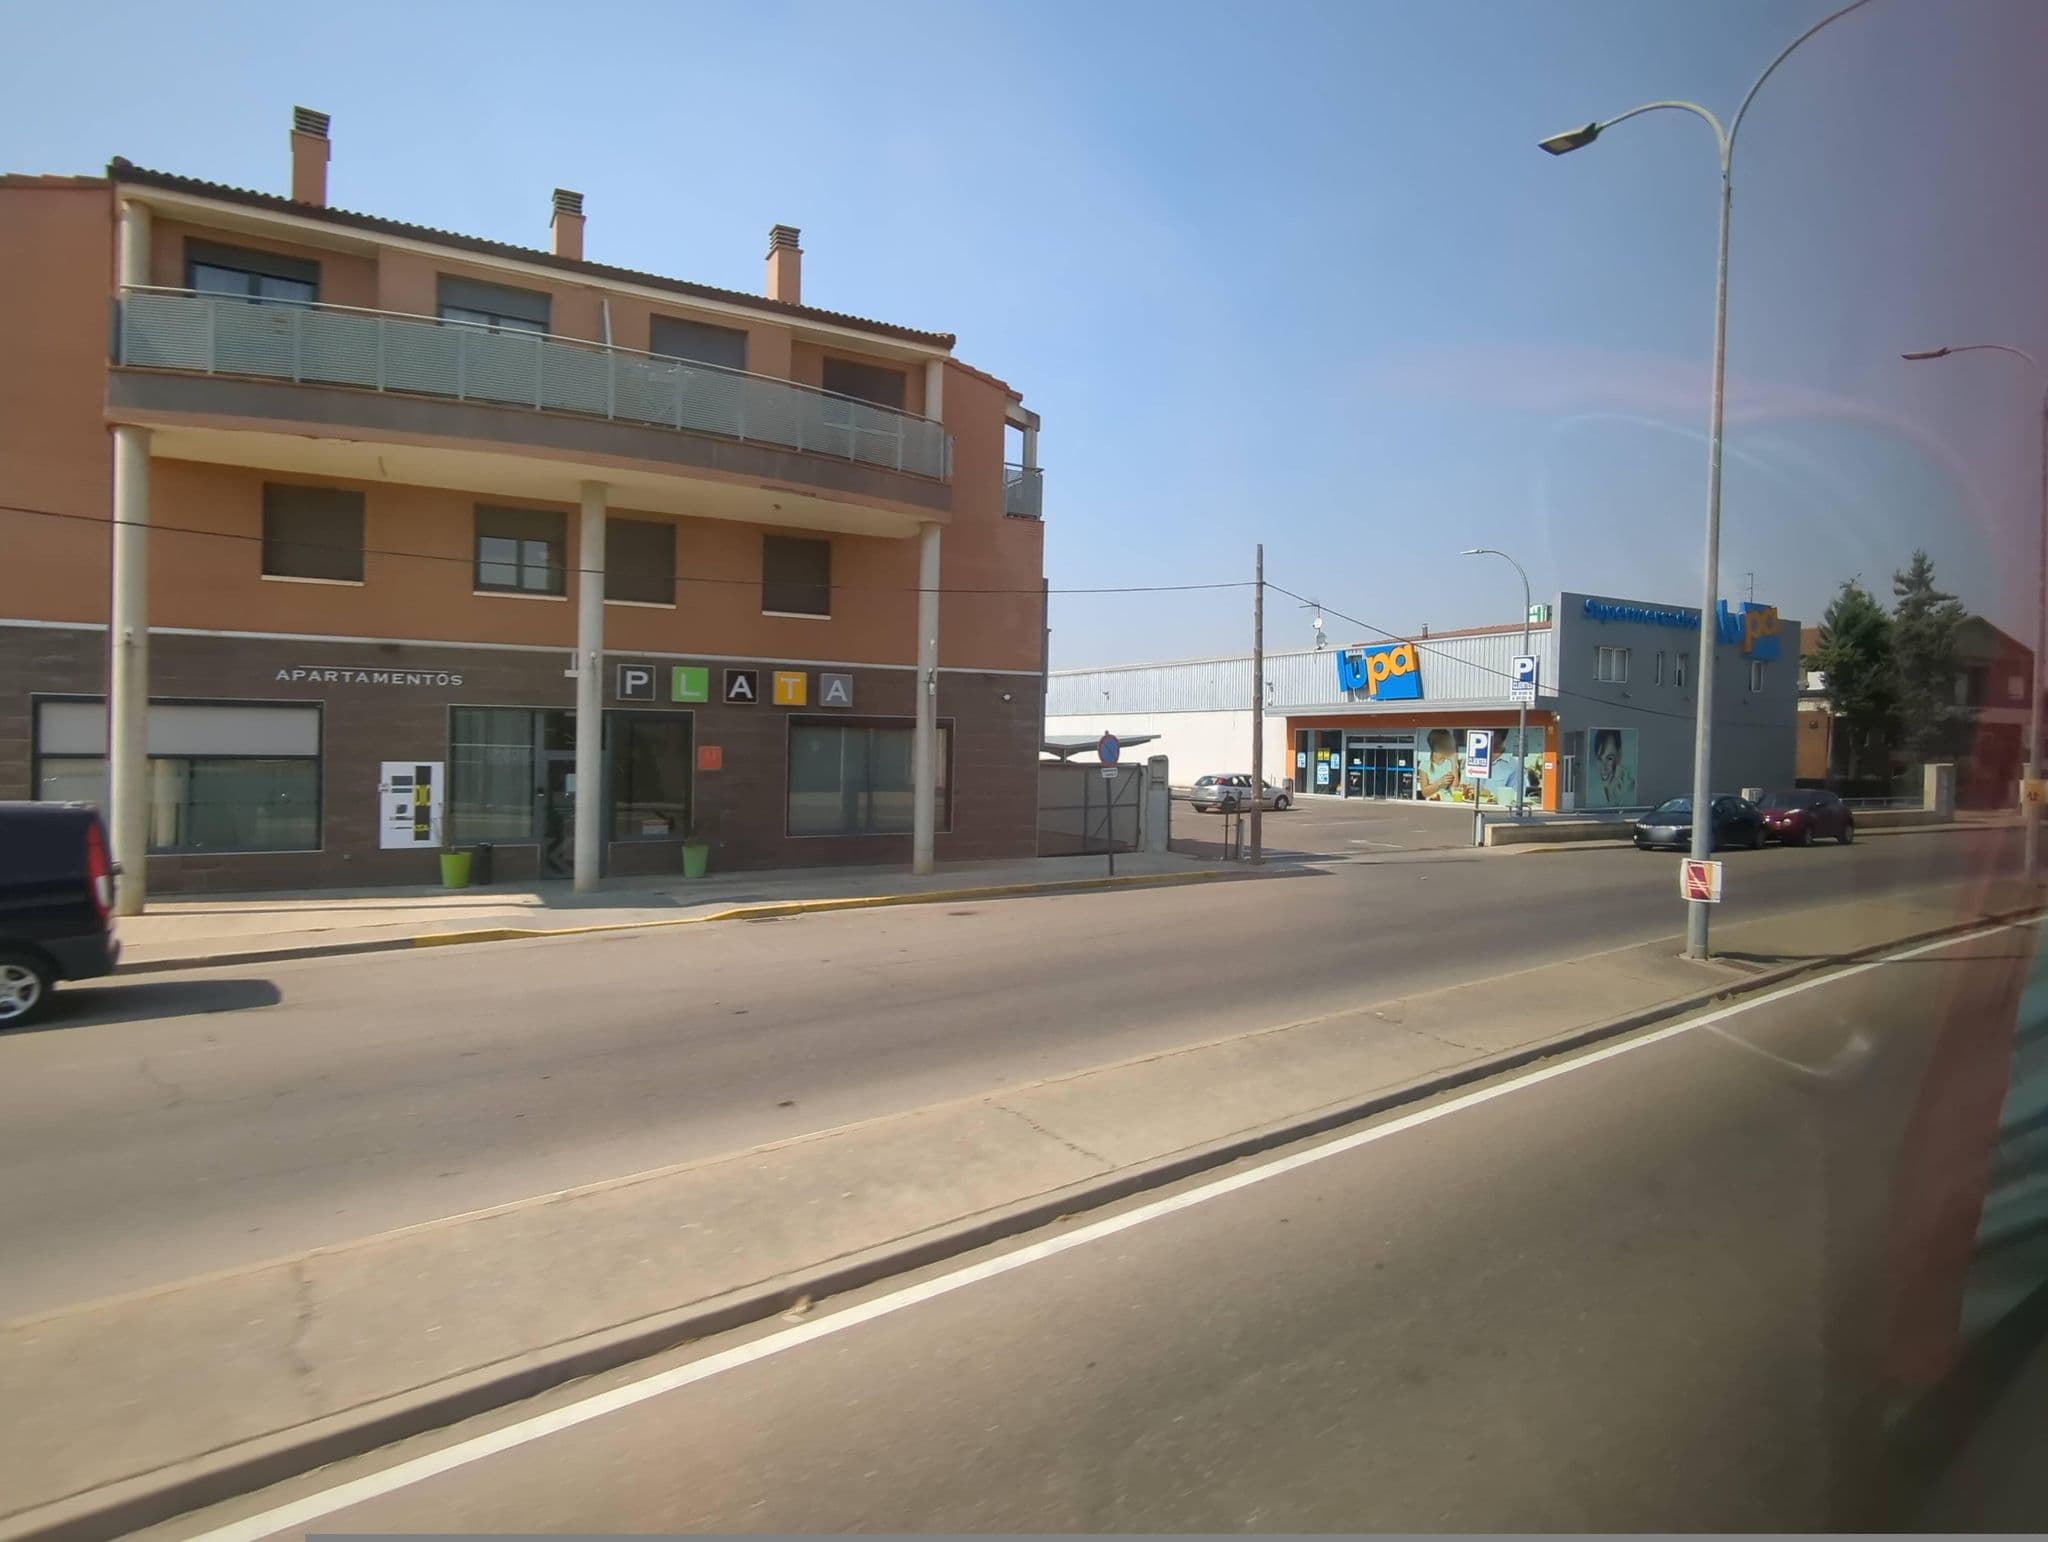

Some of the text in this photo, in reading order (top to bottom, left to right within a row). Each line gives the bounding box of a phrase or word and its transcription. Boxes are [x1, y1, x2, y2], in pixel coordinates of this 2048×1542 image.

[275, 669, 464, 686] APARTAMENTOS
[1513, 658, 1533, 682] P
[623, 669, 849, 703] PLATA
[1469, 733, 1488, 757] P
